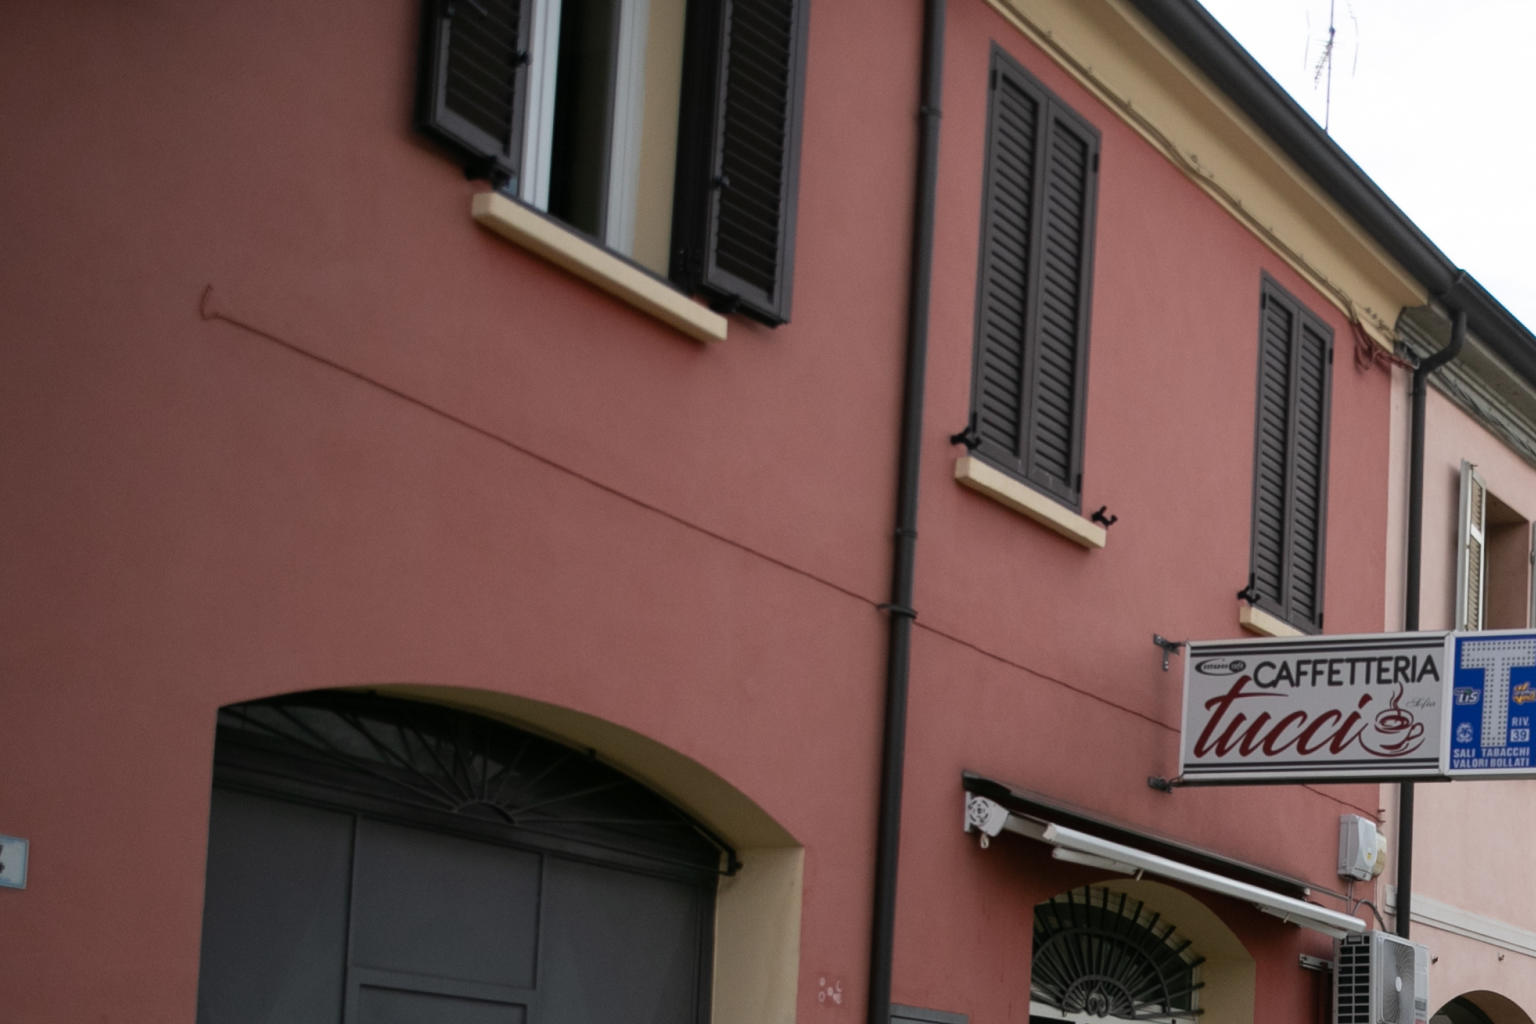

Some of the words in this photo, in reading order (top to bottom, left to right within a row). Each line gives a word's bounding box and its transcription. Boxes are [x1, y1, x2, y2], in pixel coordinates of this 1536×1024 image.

[1252, 654, 1440, 688] CAFFETTERIA
[1193, 675, 1373, 758] tucci
[1511, 716, 1529, 727] RIV.
[1512, 730, 1527, 740] 39
[1453, 748, 1476, 758] SALI
[1481, 747, 1530, 757] TABACCHI
[1453, 759, 1488, 769] VALORI
[1489, 757, 1530, 768] BOLLATI
